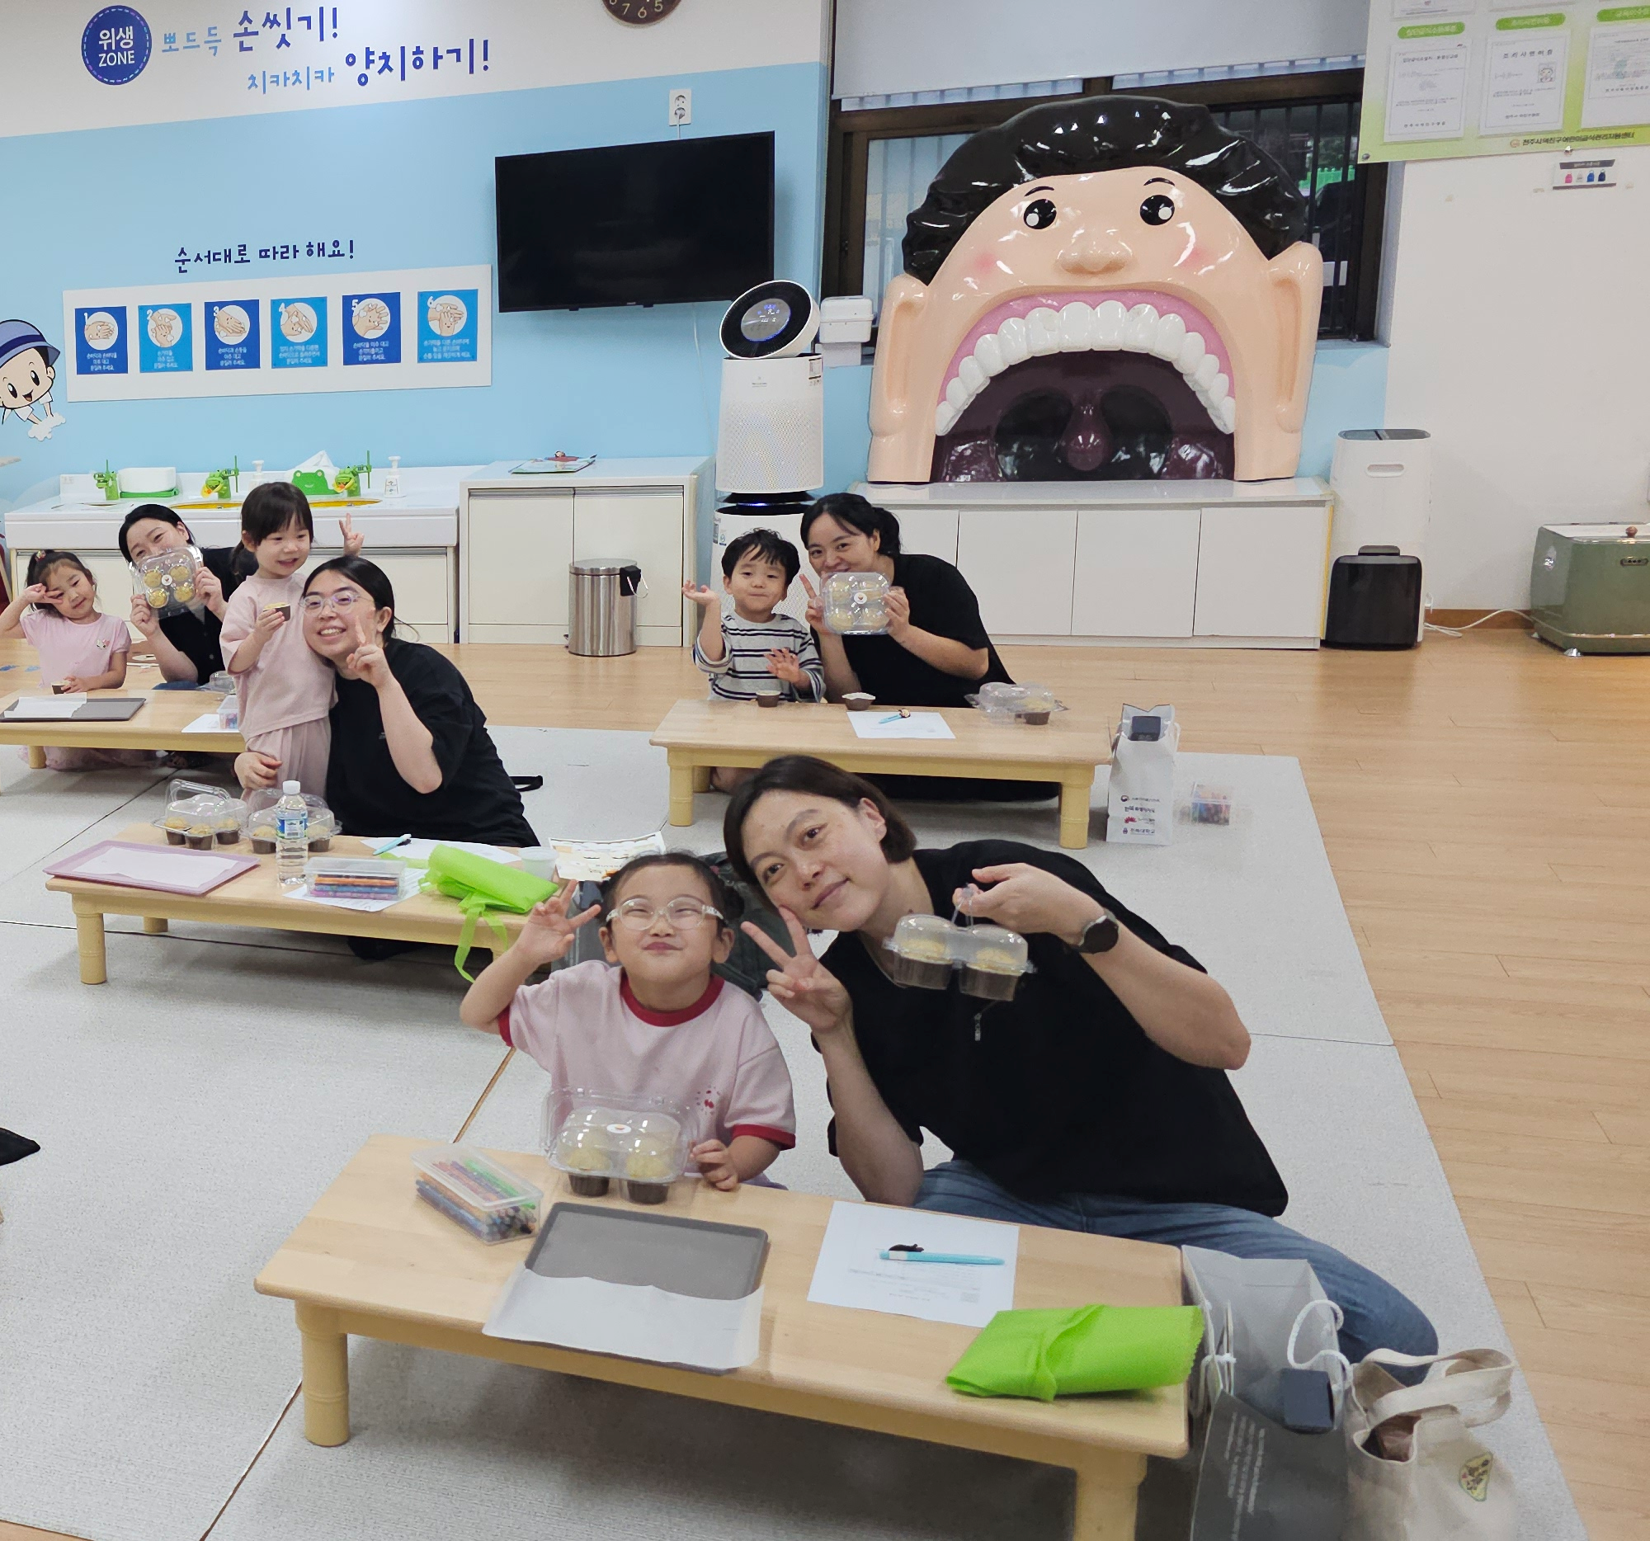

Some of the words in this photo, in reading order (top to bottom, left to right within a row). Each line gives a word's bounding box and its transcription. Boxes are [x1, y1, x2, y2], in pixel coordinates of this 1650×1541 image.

[622, 3, 630, 15] 7
[637, 6, 647, 18] 6
[654, 0, 663, 12] 5
[98, 25, 134, 51] 위생
[161, 26, 222, 57] 뽀드득
[233, 6, 339, 52] 손씻기!
[98, 50, 135, 67] ZONE
[247, 65, 335, 94] 치카치카
[345, 38, 489, 87] 양치하기!
[174, 243, 251, 274] 순서대로
[258, 244, 300, 261] 따라
[305, 239, 354, 260] 해요!
